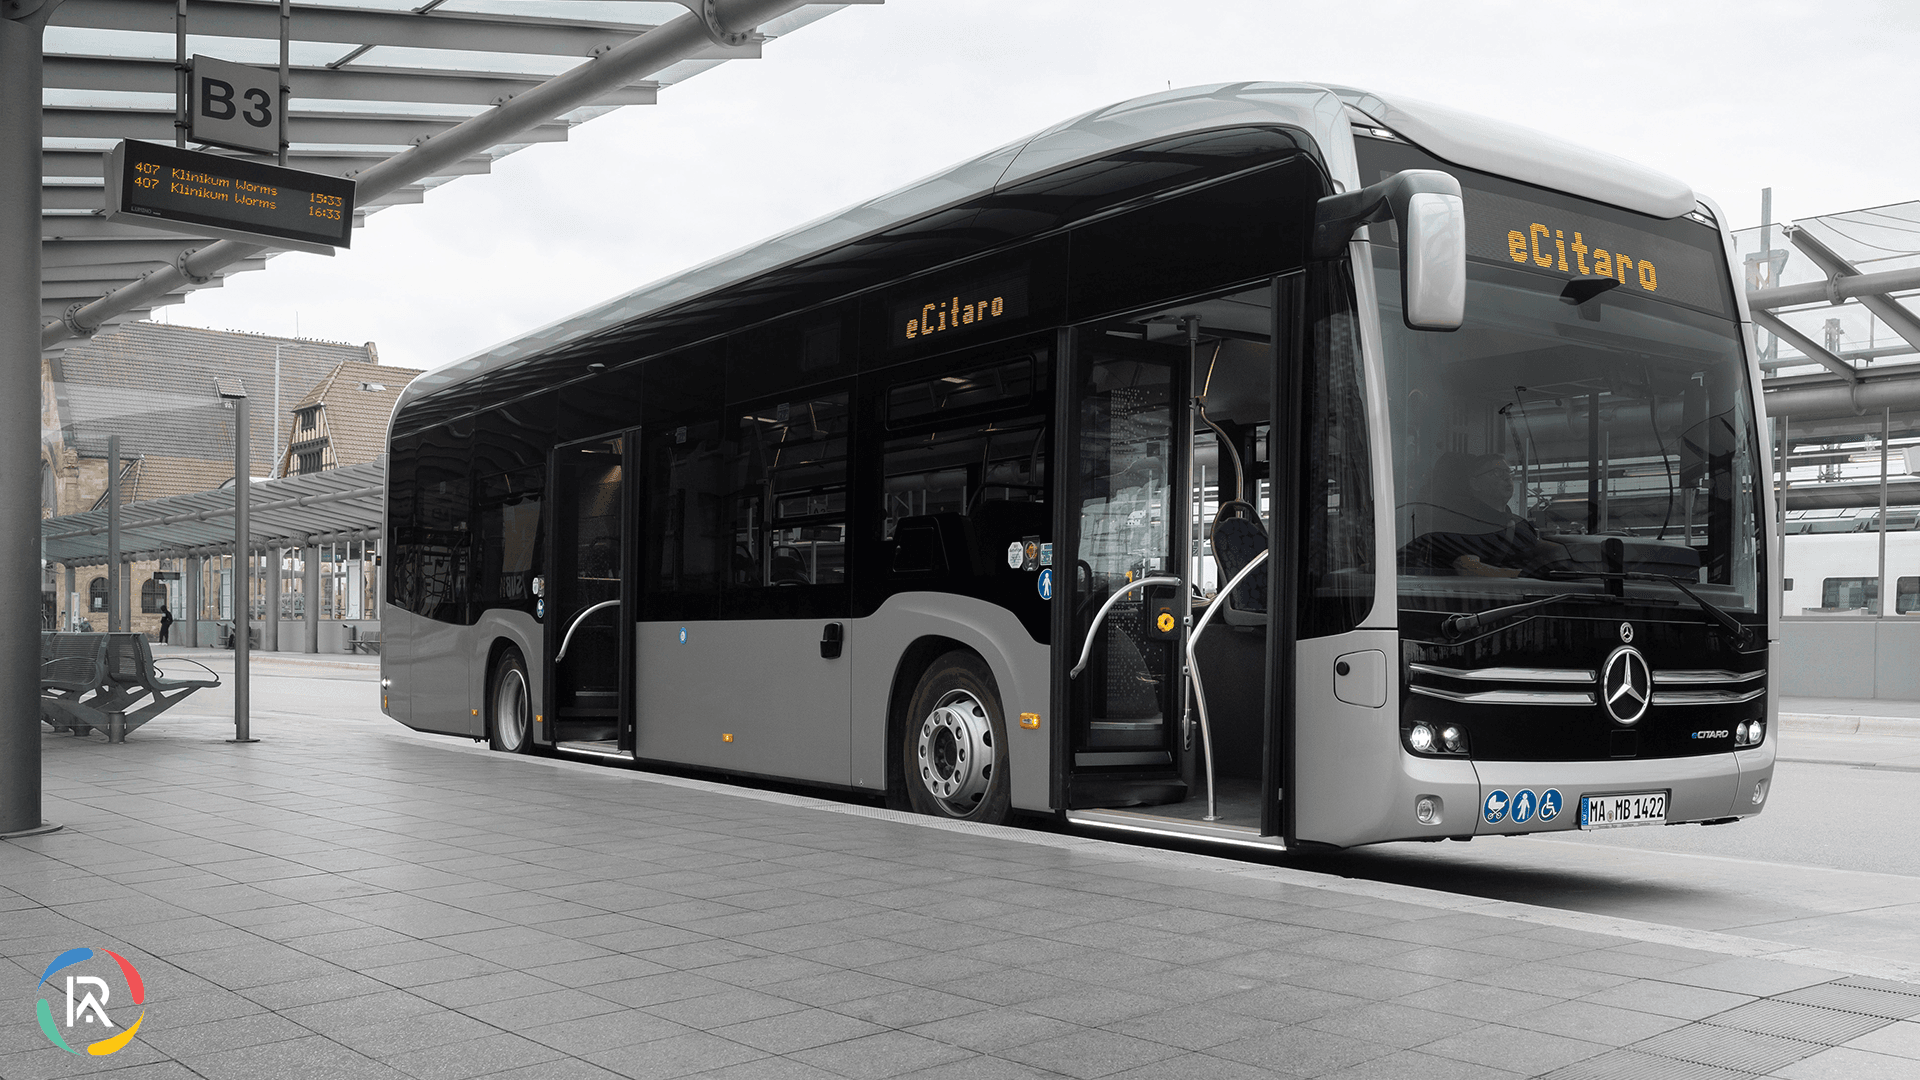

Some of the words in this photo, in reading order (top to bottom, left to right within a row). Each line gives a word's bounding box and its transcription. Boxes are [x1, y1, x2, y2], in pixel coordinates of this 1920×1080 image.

[201, 76, 272, 128] B3
[134, 177, 159, 189] 407
[170, 182, 229, 201] Klinikum
[235, 193, 276, 210] Worms
[309, 206, 341, 220] 16:33
[135, 162, 160, 175] 407
[172, 168, 229, 187] Klinikum
[236, 179, 277, 196] Worms
[310, 193, 342, 207] 15:33
[1507, 222, 1658, 292] eCitaro
[905, 296, 1003, 339] eCitaro
[1691, 730, 1729, 739] eCITARO
[1590, 800, 1605, 822] MA
[1615, 799, 1631, 820] MB
[1634, 797, 1664, 819] 1422
